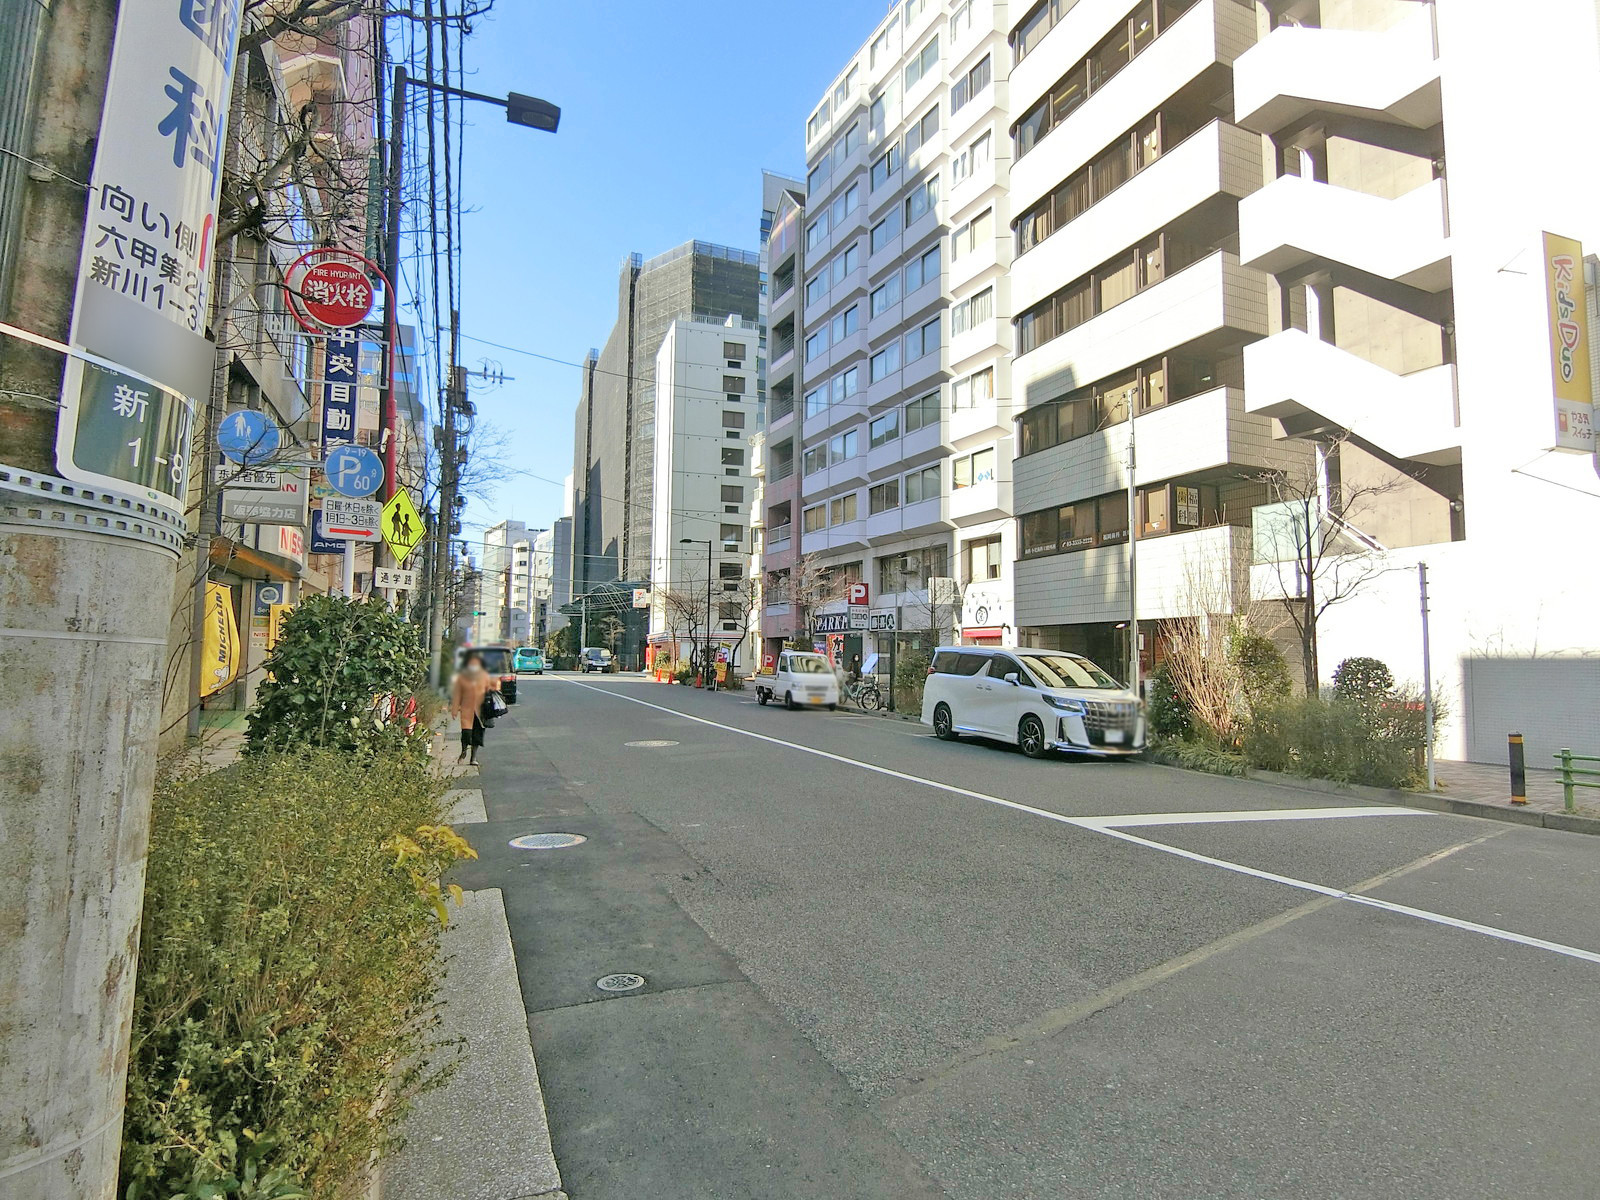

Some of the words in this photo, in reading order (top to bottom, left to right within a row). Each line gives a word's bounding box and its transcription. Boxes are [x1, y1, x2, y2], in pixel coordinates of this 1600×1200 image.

[101, 184, 198, 260] 向い側
[313, 268, 329, 277] FIRE
[330, 270, 361, 280] HYDRANT
[307, 279, 369, 309] 消火栓
[128, 437, 184, 484] 1-8
[344, 447, 367, 457] 9-19
[338, 455, 361, 488] P
[380, 571, 412, 586] 通学路
[850, 585, 866, 604] P
[215, 591, 228, 664] MICHELIN
